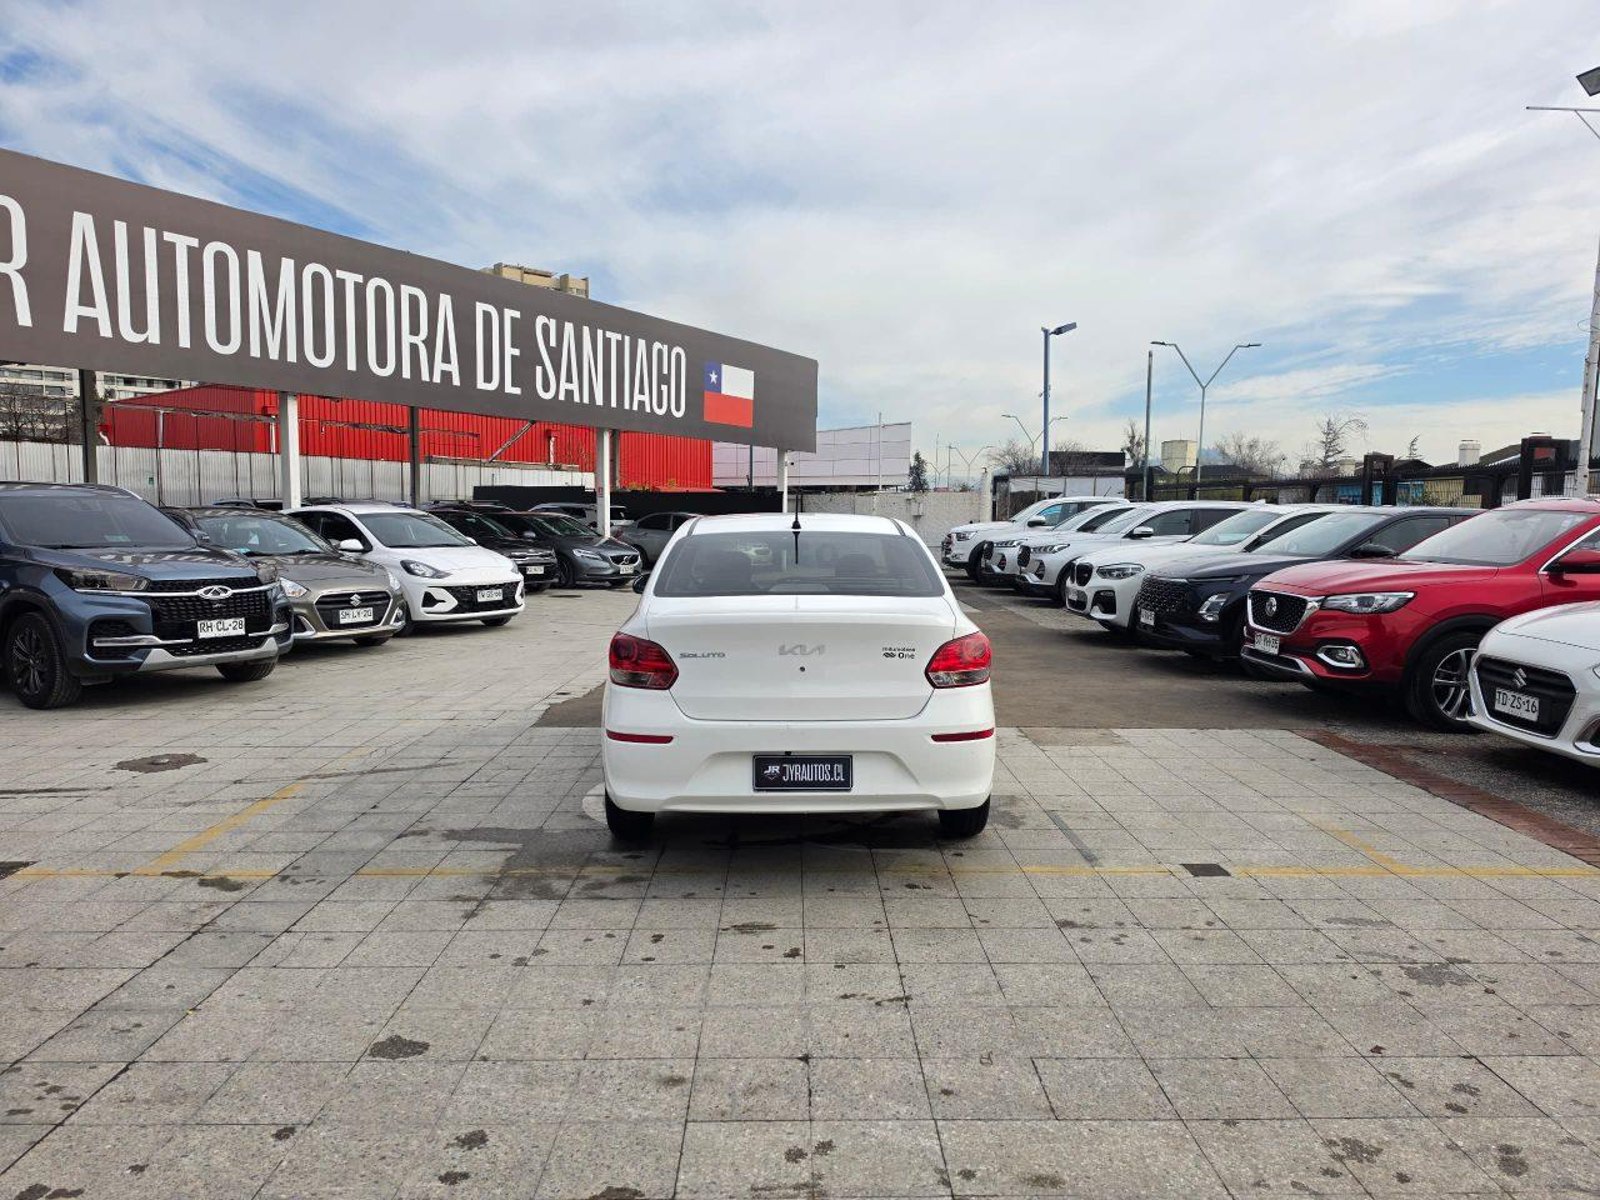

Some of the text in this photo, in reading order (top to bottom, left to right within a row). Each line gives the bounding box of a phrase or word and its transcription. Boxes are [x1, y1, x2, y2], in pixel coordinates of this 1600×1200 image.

[63, 210, 461, 387] AUTOMOTORA
[475, 301, 522, 395] DE
[535, 314, 687, 418] SANTIAGO
[782, 763, 845, 781] JYRAUTOS.CL
